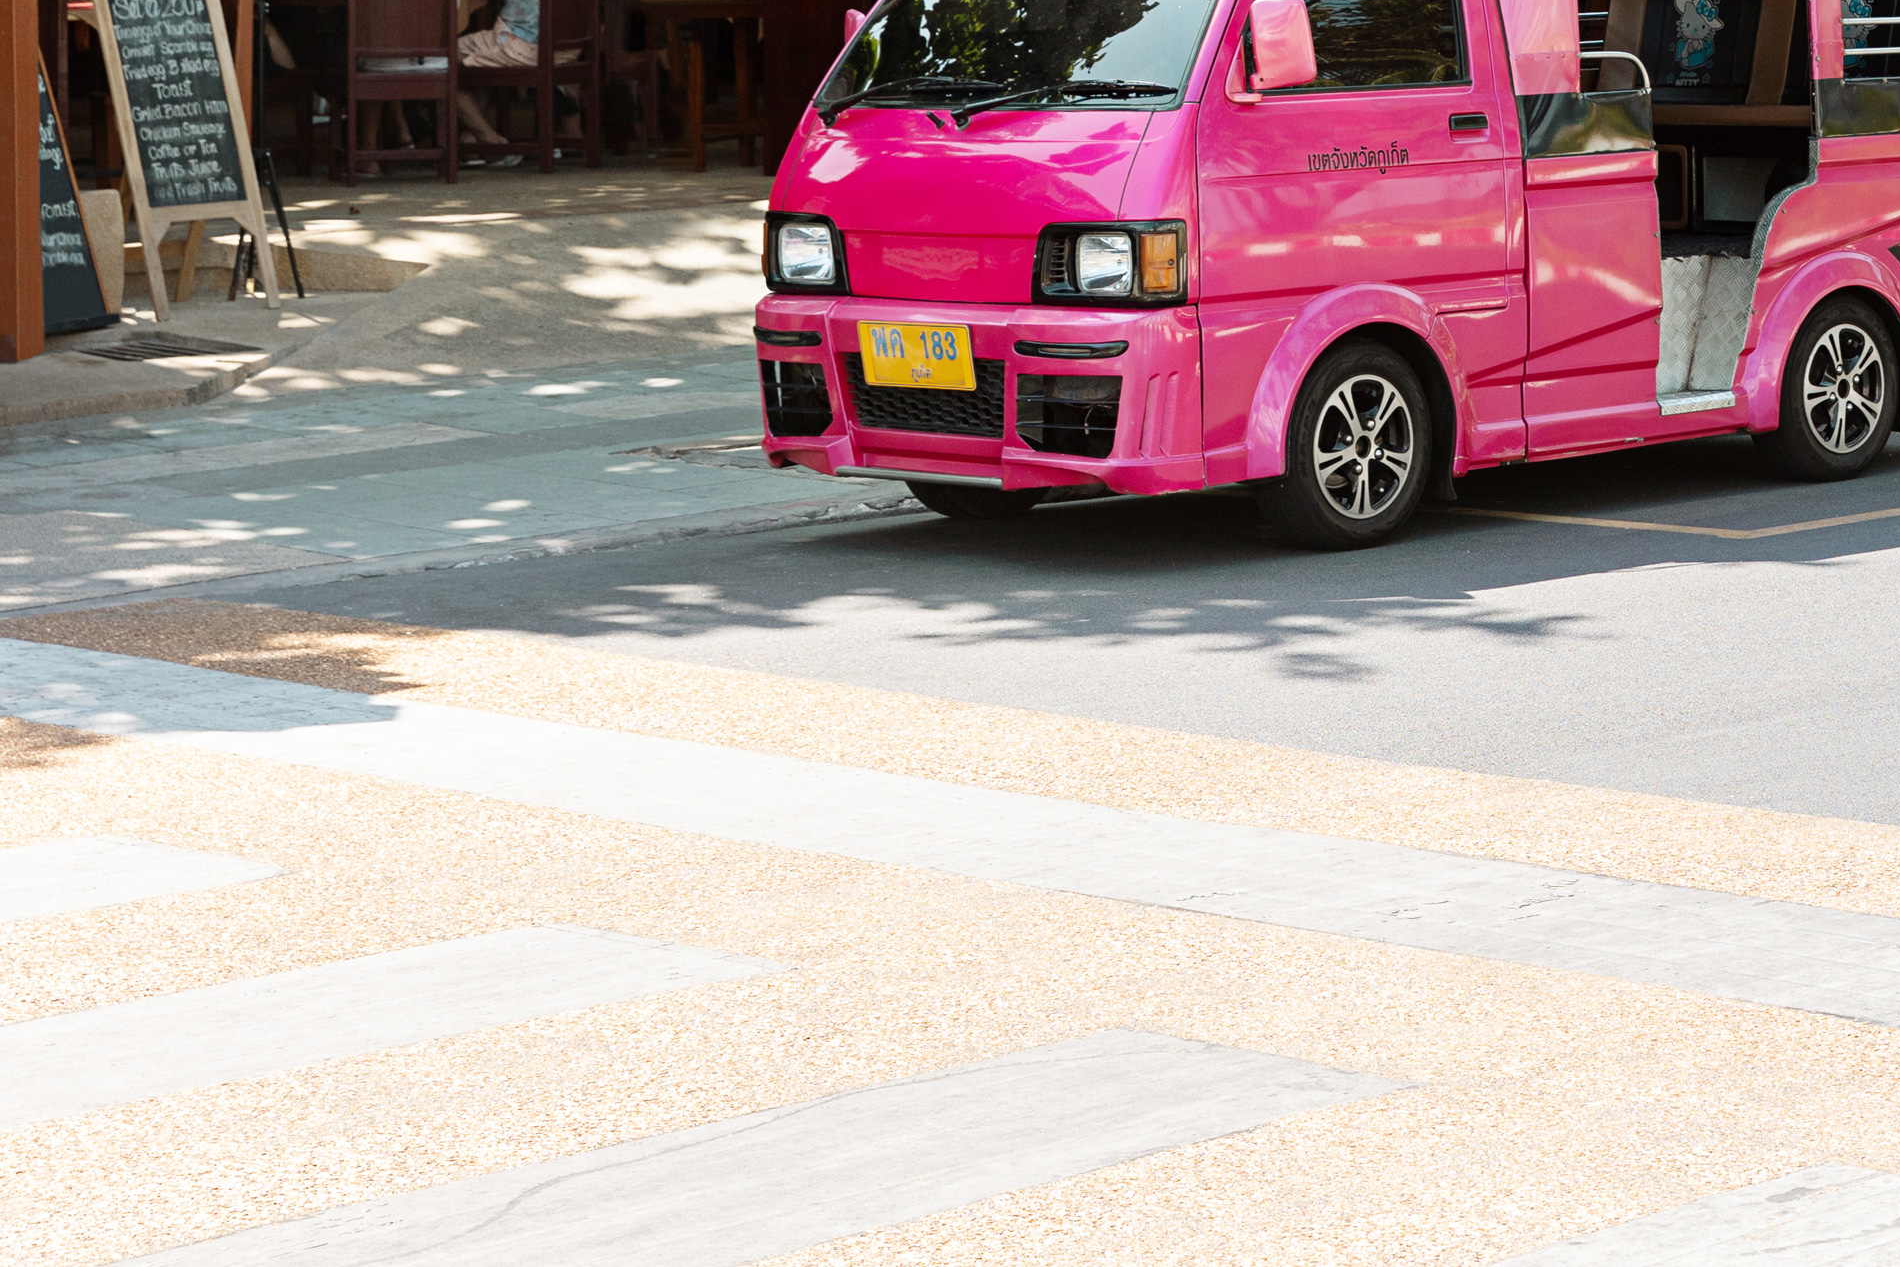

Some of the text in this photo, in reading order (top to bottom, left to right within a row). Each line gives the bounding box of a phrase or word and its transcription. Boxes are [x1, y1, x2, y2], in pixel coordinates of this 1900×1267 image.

[152, 78, 193, 100] Toast
[183, 145, 197, 157] or
[198, 139, 219, 156] Tea
[1307, 140, 1409, 174] เขตจังหวัดภูเก็ต
[188, 159, 222, 177] Juice
[919, 331, 957, 361] 183
